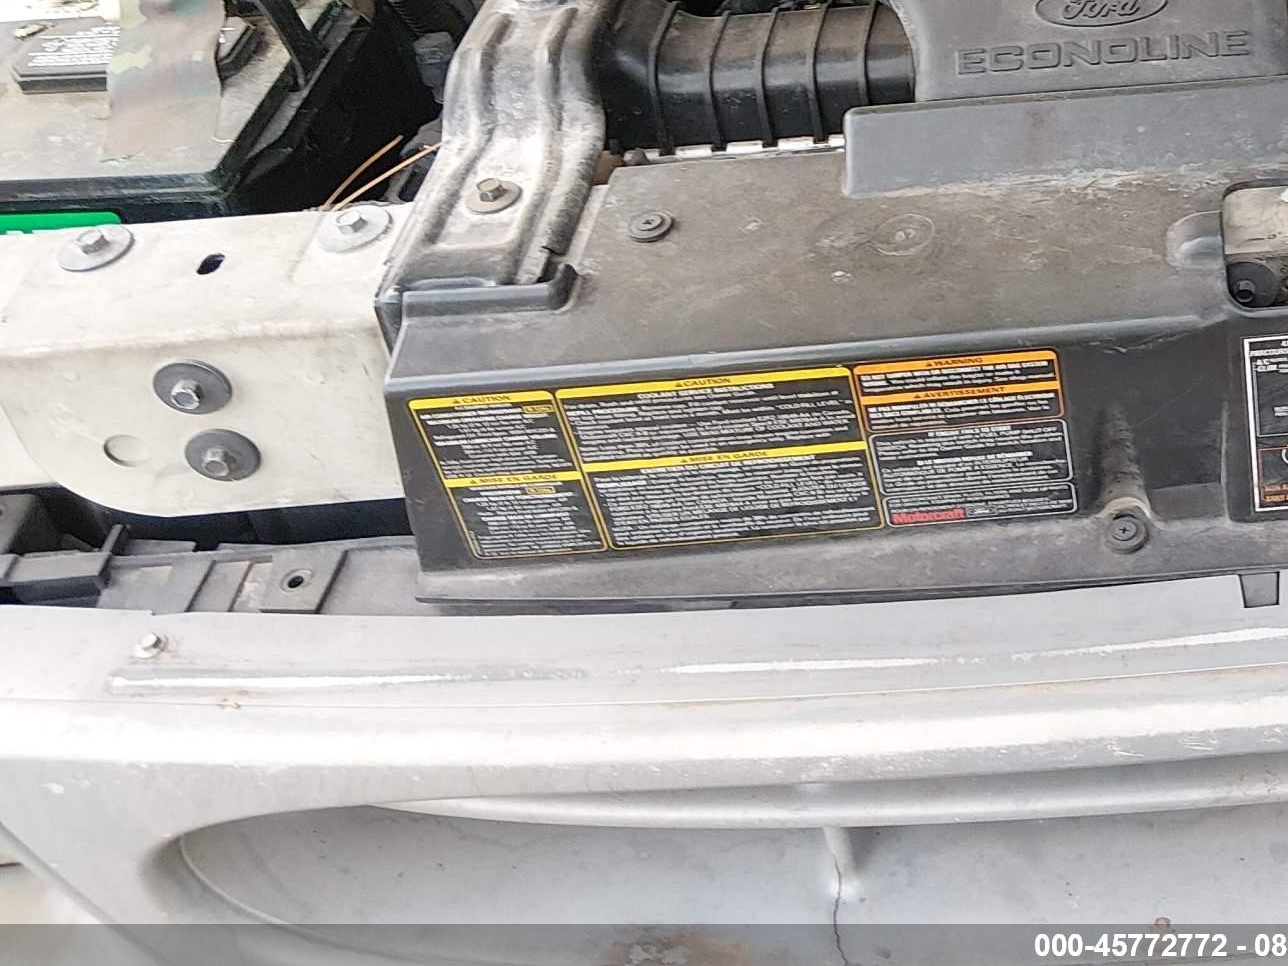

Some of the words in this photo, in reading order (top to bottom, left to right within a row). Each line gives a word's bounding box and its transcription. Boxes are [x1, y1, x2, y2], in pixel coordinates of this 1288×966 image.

[955, 30, 1250, 75] ECONOLINE
[934, 357, 983, 367] WARNING
[682, 377, 731, 387] CAUTION
[923, 386, 1006, 399] AVERTISSEMENT
[461, 394, 512, 404] CAUTION
[892, 507, 966, 524] Motorcraft
